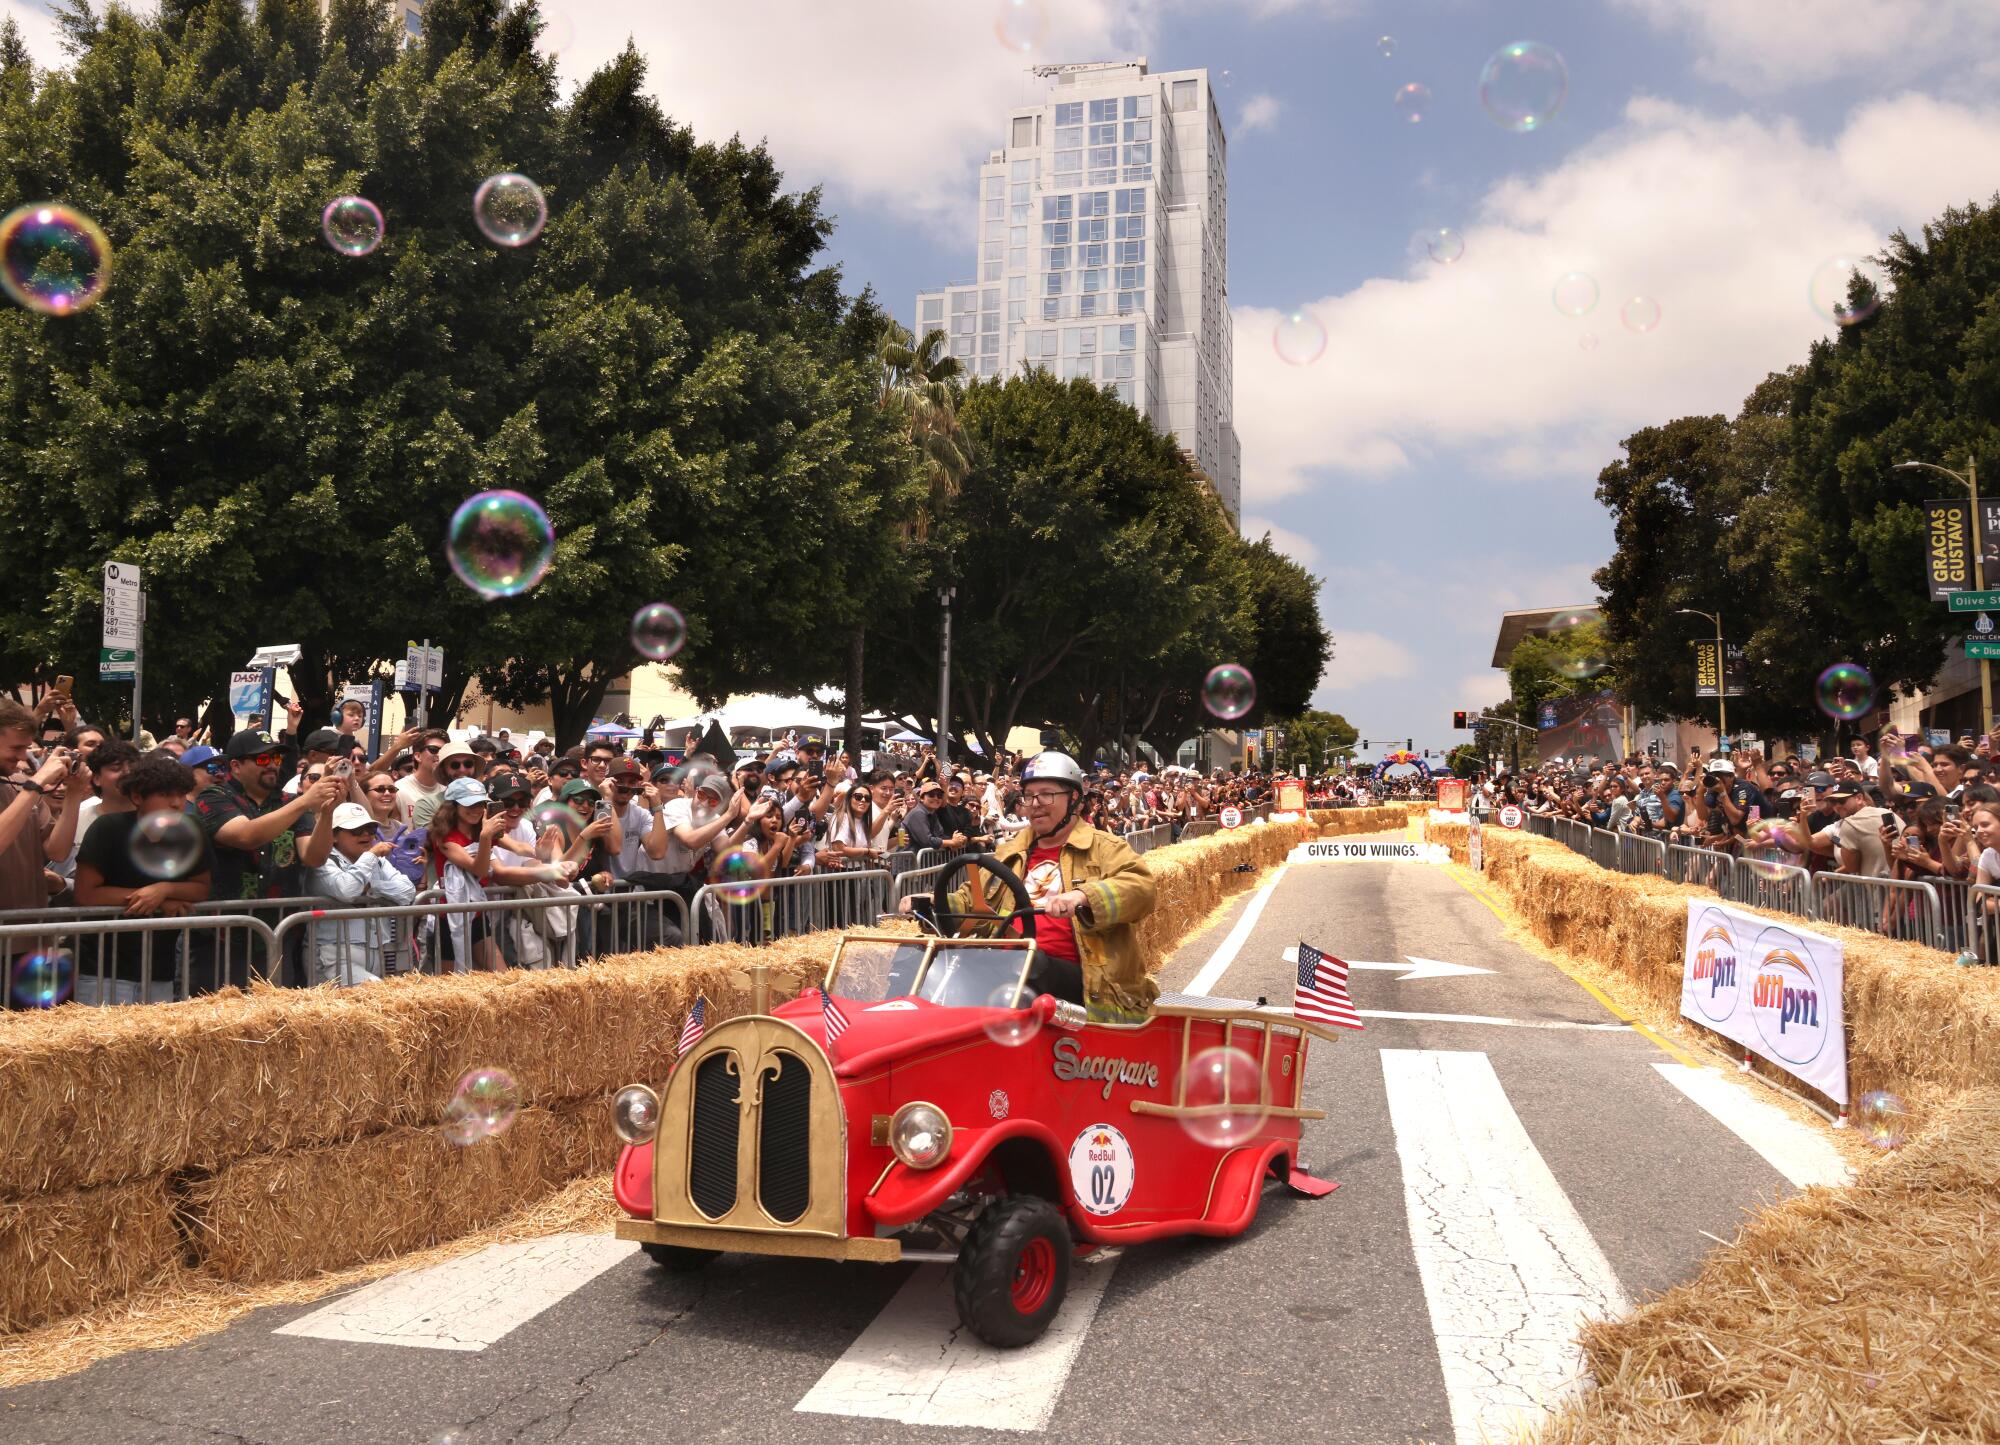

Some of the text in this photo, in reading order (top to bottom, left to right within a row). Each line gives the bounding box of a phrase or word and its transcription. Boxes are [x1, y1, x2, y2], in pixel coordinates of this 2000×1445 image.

[1931, 508, 1948, 582] GRACIAS
[1947, 508, 1965, 582] GUSTAVO
[120, 578, 138, 587] Metro
[106, 588, 116, 597] 70
[106, 597, 115, 606] 76
[1955, 597, 1985, 606] Olive
[105, 607, 115, 616] 78
[105, 617, 119, 627] 487
[105, 627, 119, 636] 489
[1698, 644, 1706, 686] GRACIAS
[1706, 644, 1716, 686] GUSTAVO
[233, 674, 263, 683] DASH
[371, 691, 379, 734] LADOT
[1308, 844, 1419, 857] GIVES YOU WIIINGS.
[1693, 947, 1736, 998] ampm
[1753, 973, 1818, 1034] ampm
[1053, 1037, 1159, 1100] Seagrave
[1088, 1150, 1116, 1161] Red Bull
[1091, 1165, 1116, 1206] 02
